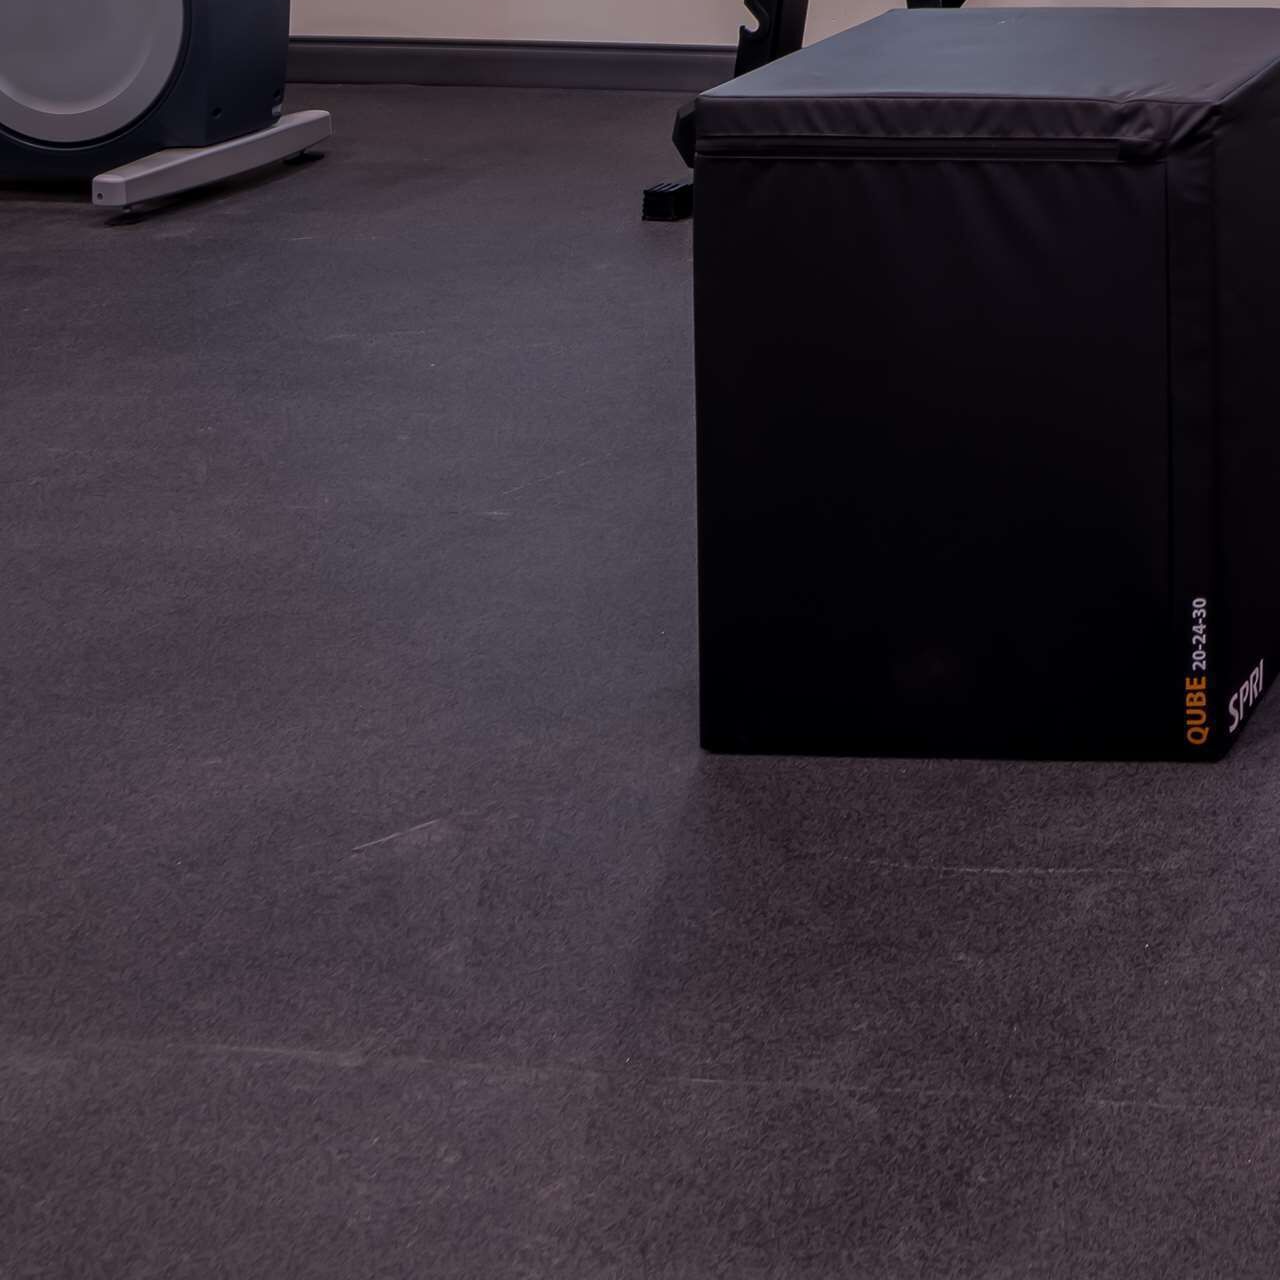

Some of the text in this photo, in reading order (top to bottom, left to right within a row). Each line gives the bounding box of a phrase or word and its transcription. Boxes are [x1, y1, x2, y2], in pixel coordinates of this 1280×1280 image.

[1184, 596, 1210, 745] QUBE 20-24-30
[1228, 657, 1264, 734] SPRI
